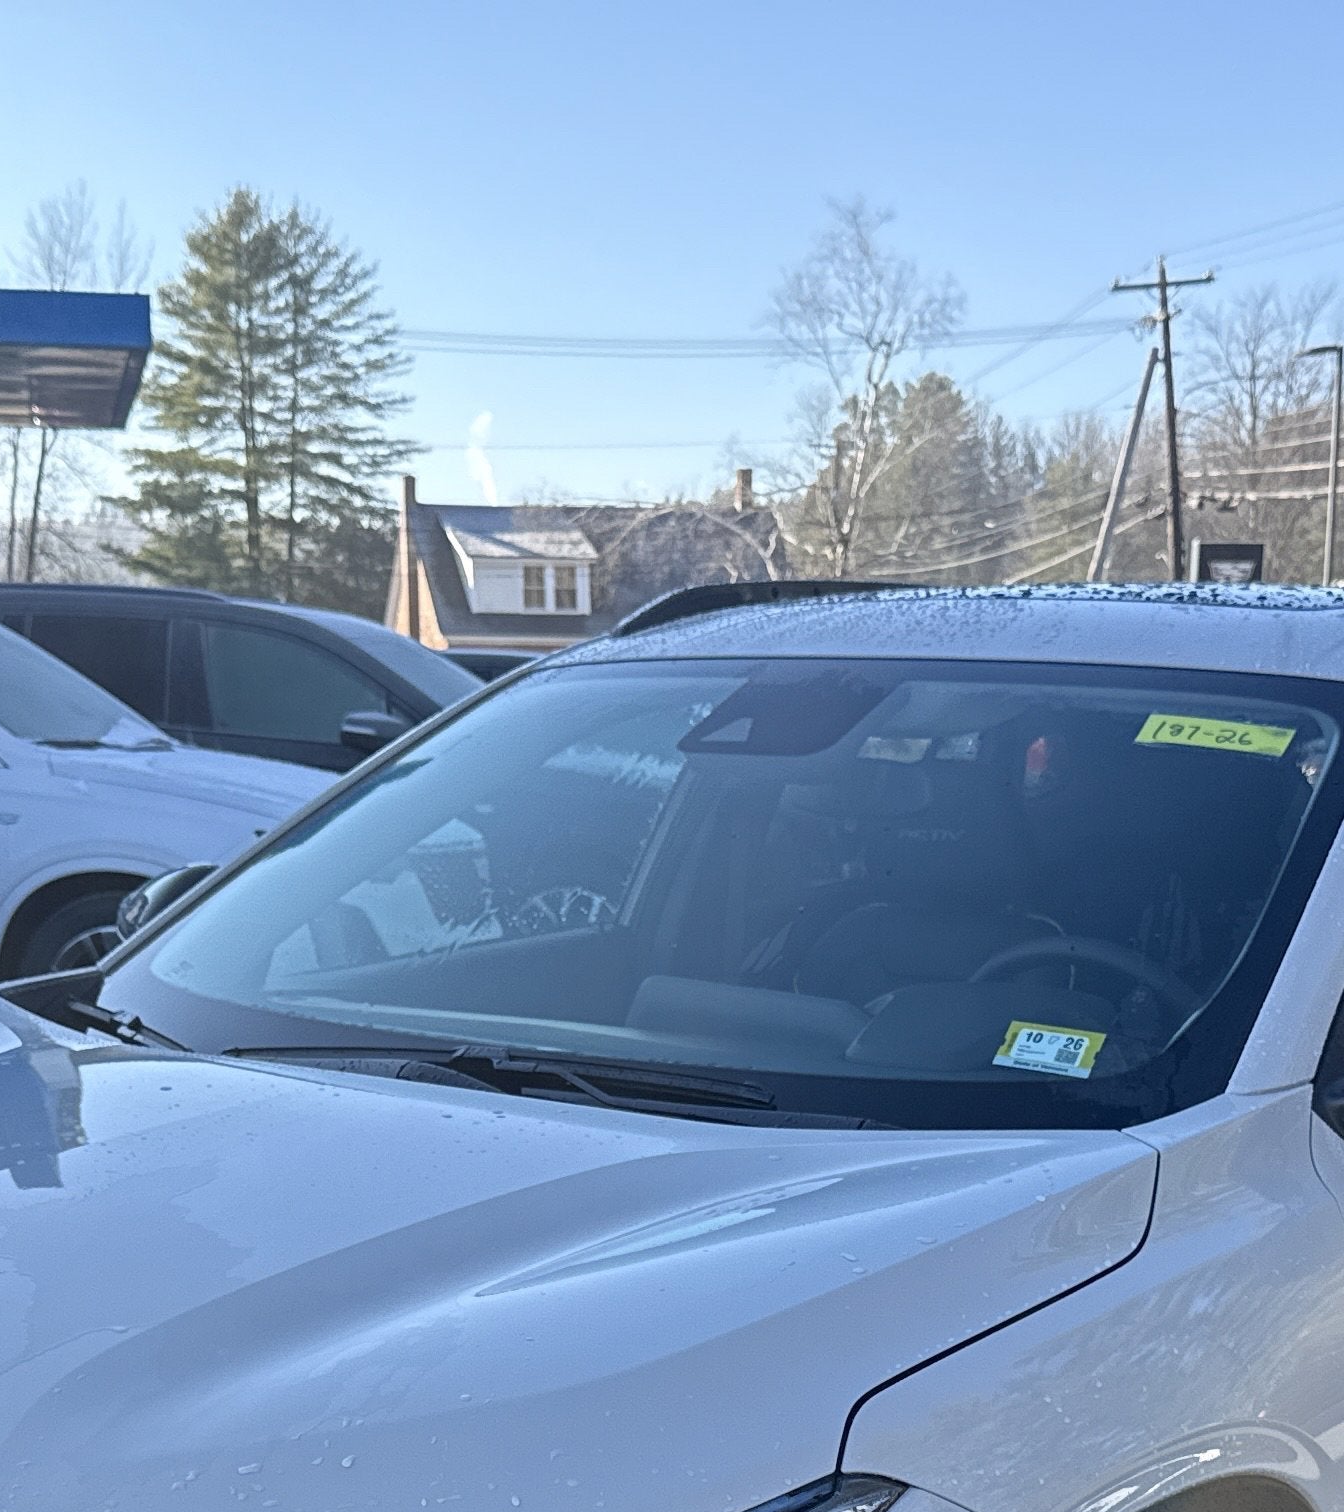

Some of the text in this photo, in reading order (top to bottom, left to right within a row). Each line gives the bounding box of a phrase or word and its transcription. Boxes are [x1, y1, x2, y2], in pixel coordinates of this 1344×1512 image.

[1152, 721, 1253, 746] 187-26
[1025, 1031, 1044, 1044] 10
[1062, 1037, 1085, 1051] 26
